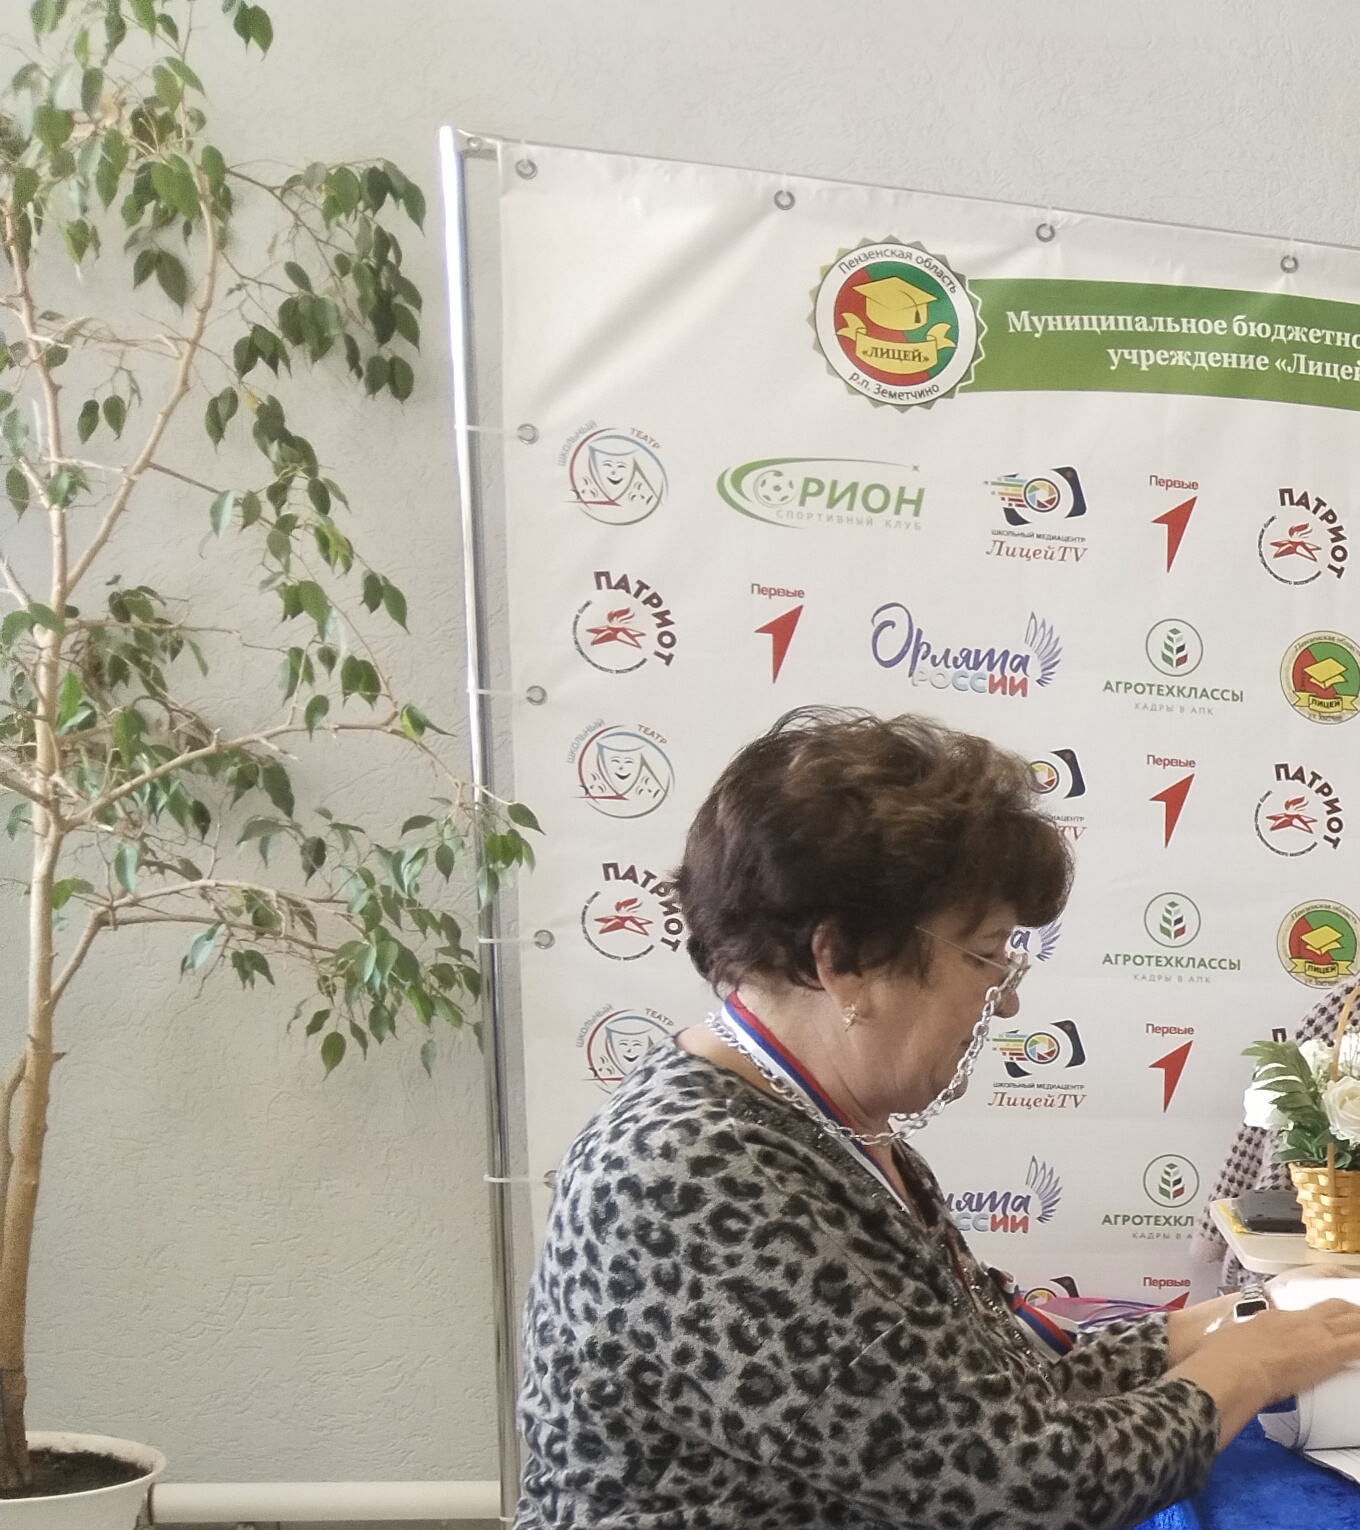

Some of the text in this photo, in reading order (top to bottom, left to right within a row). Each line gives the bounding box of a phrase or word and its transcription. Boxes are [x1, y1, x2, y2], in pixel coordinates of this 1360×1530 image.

[839, 248, 957, 294] Пензенская область
[1006, 310, 1228, 338] Муниципальное
[1107, 347, 1269, 371] учреждение
[873, 382, 940, 401] Земетчино
[557, 419, 660, 467] ШКОЛЬНЫЙ ТЕАТР
[1149, 474, 1199, 491] Первые
[776, 509, 922, 531] СПОРТИВНЫЙ КЛУБ
[1279, 488, 1348, 579] ПАТРИОТ
[751, 583, 805, 599] Первые
[594, 570, 677, 667] ПАТРИОТ
[871, 602, 1030, 678] Орлята
[1102, 680, 1243, 703] АГРОТЕХКЛАССЫ
[1135, 703, 1174, 712] КАДРЫ
[1190, 707, 1213, 715] АПК
[567, 718, 667, 764] ШКОЛЬНЫЙ ТЕАТР
[1146, 754, 1196, 769] Первые
[1274, 763, 1344, 850] ПАТРИОТ
[602, 862, 682, 952] ПАТРИОТ
[1102, 952, 1241, 971] АГРОТЕХКЛАССЫ
[1133, 974, 1172, 983] КАДРЫ
[1188, 976, 1211, 984] АПК
[645, 1008, 675, 1027] ТЕАТР
[1145, 1023, 1194, 1036] Первые
[955, 1212, 1029, 1233] ССИИ
[1101, 1214, 1194, 1227] АГРОТЕХКЛ
[1132, 1232, 1170, 1240] КАДРЫ
[1143, 1277, 1191, 1289] Первые
